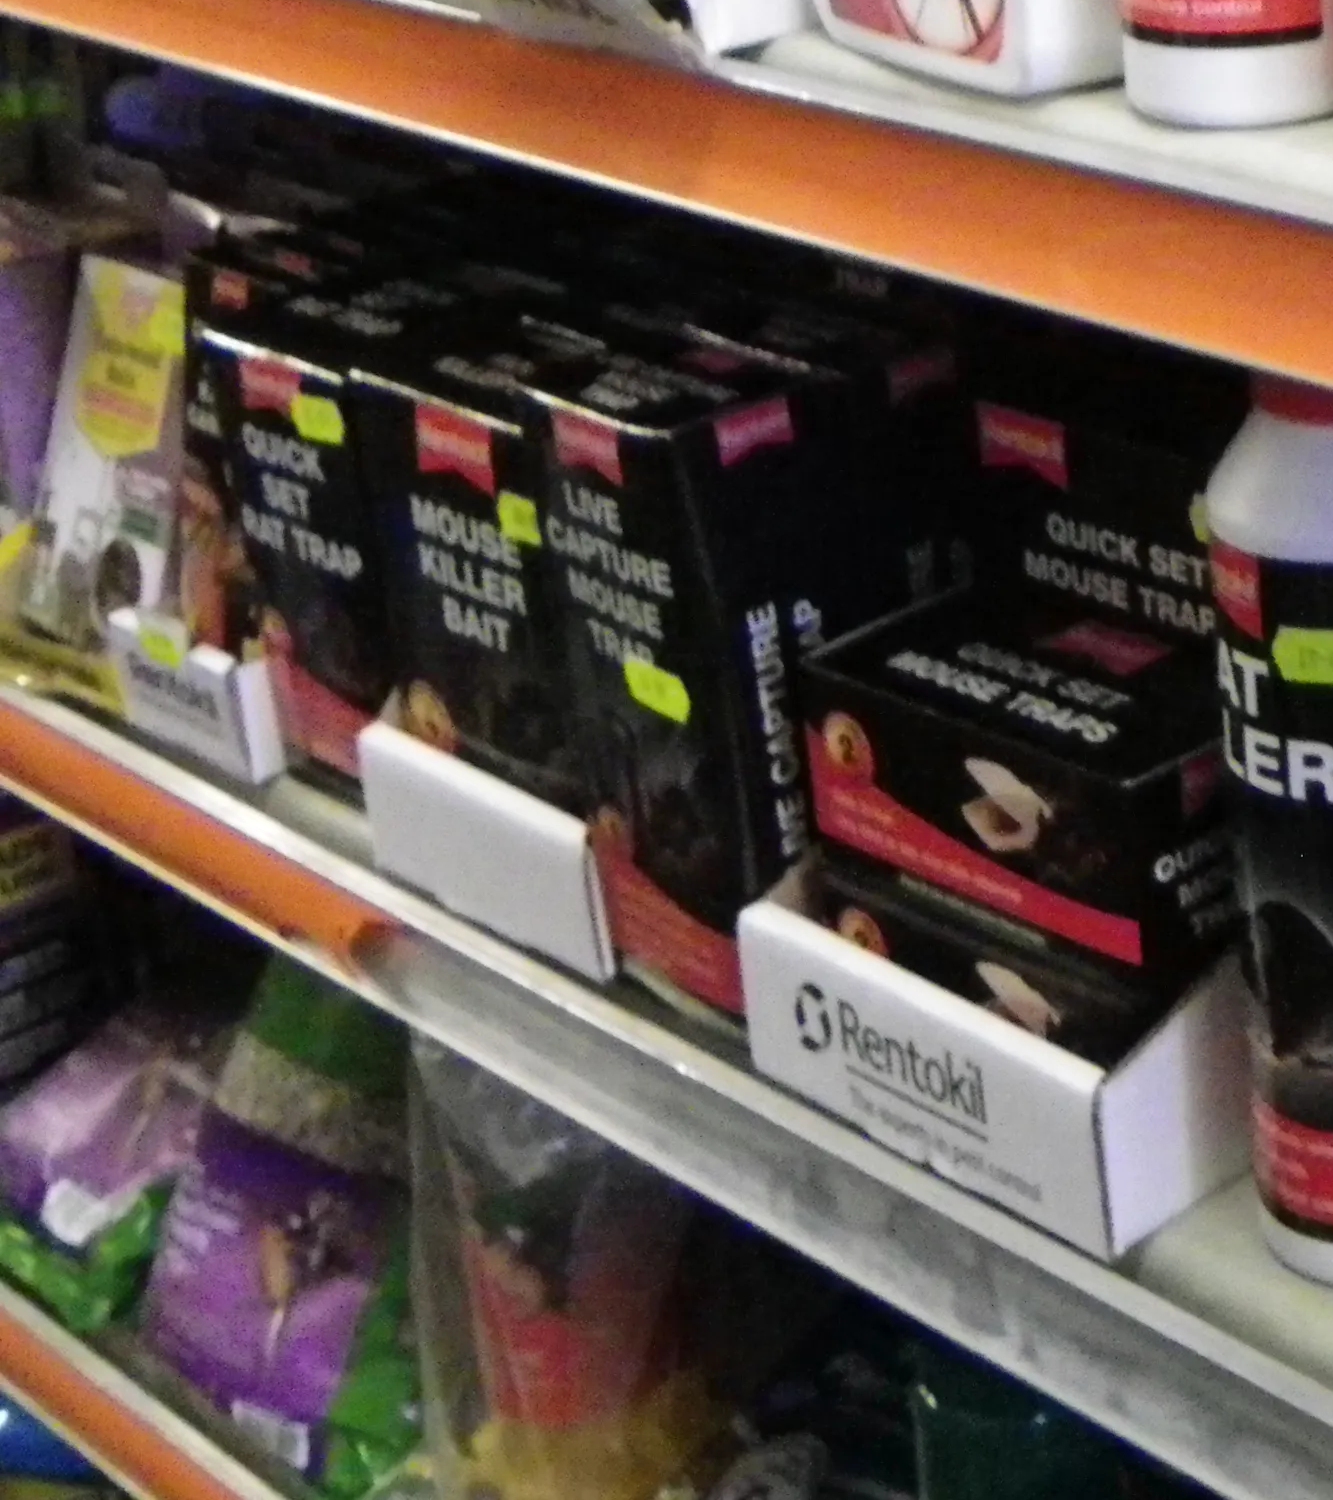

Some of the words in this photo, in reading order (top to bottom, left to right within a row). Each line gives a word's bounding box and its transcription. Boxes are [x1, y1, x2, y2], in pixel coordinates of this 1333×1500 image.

[417, 541, 527, 617] KILLER
[545, 514, 675, 600] CAPTURE
[1045, 511, 1140, 568] QUICK
[1149, 543, 1210, 587] SET
[441, 594, 510, 653] BAIT
[566, 565, 666, 644] MOUSE
[1023, 548, 1130, 612] MOUSE
[1139, 586, 1217, 637] TRAP
[836, 996, 990, 1126] Rentokil
